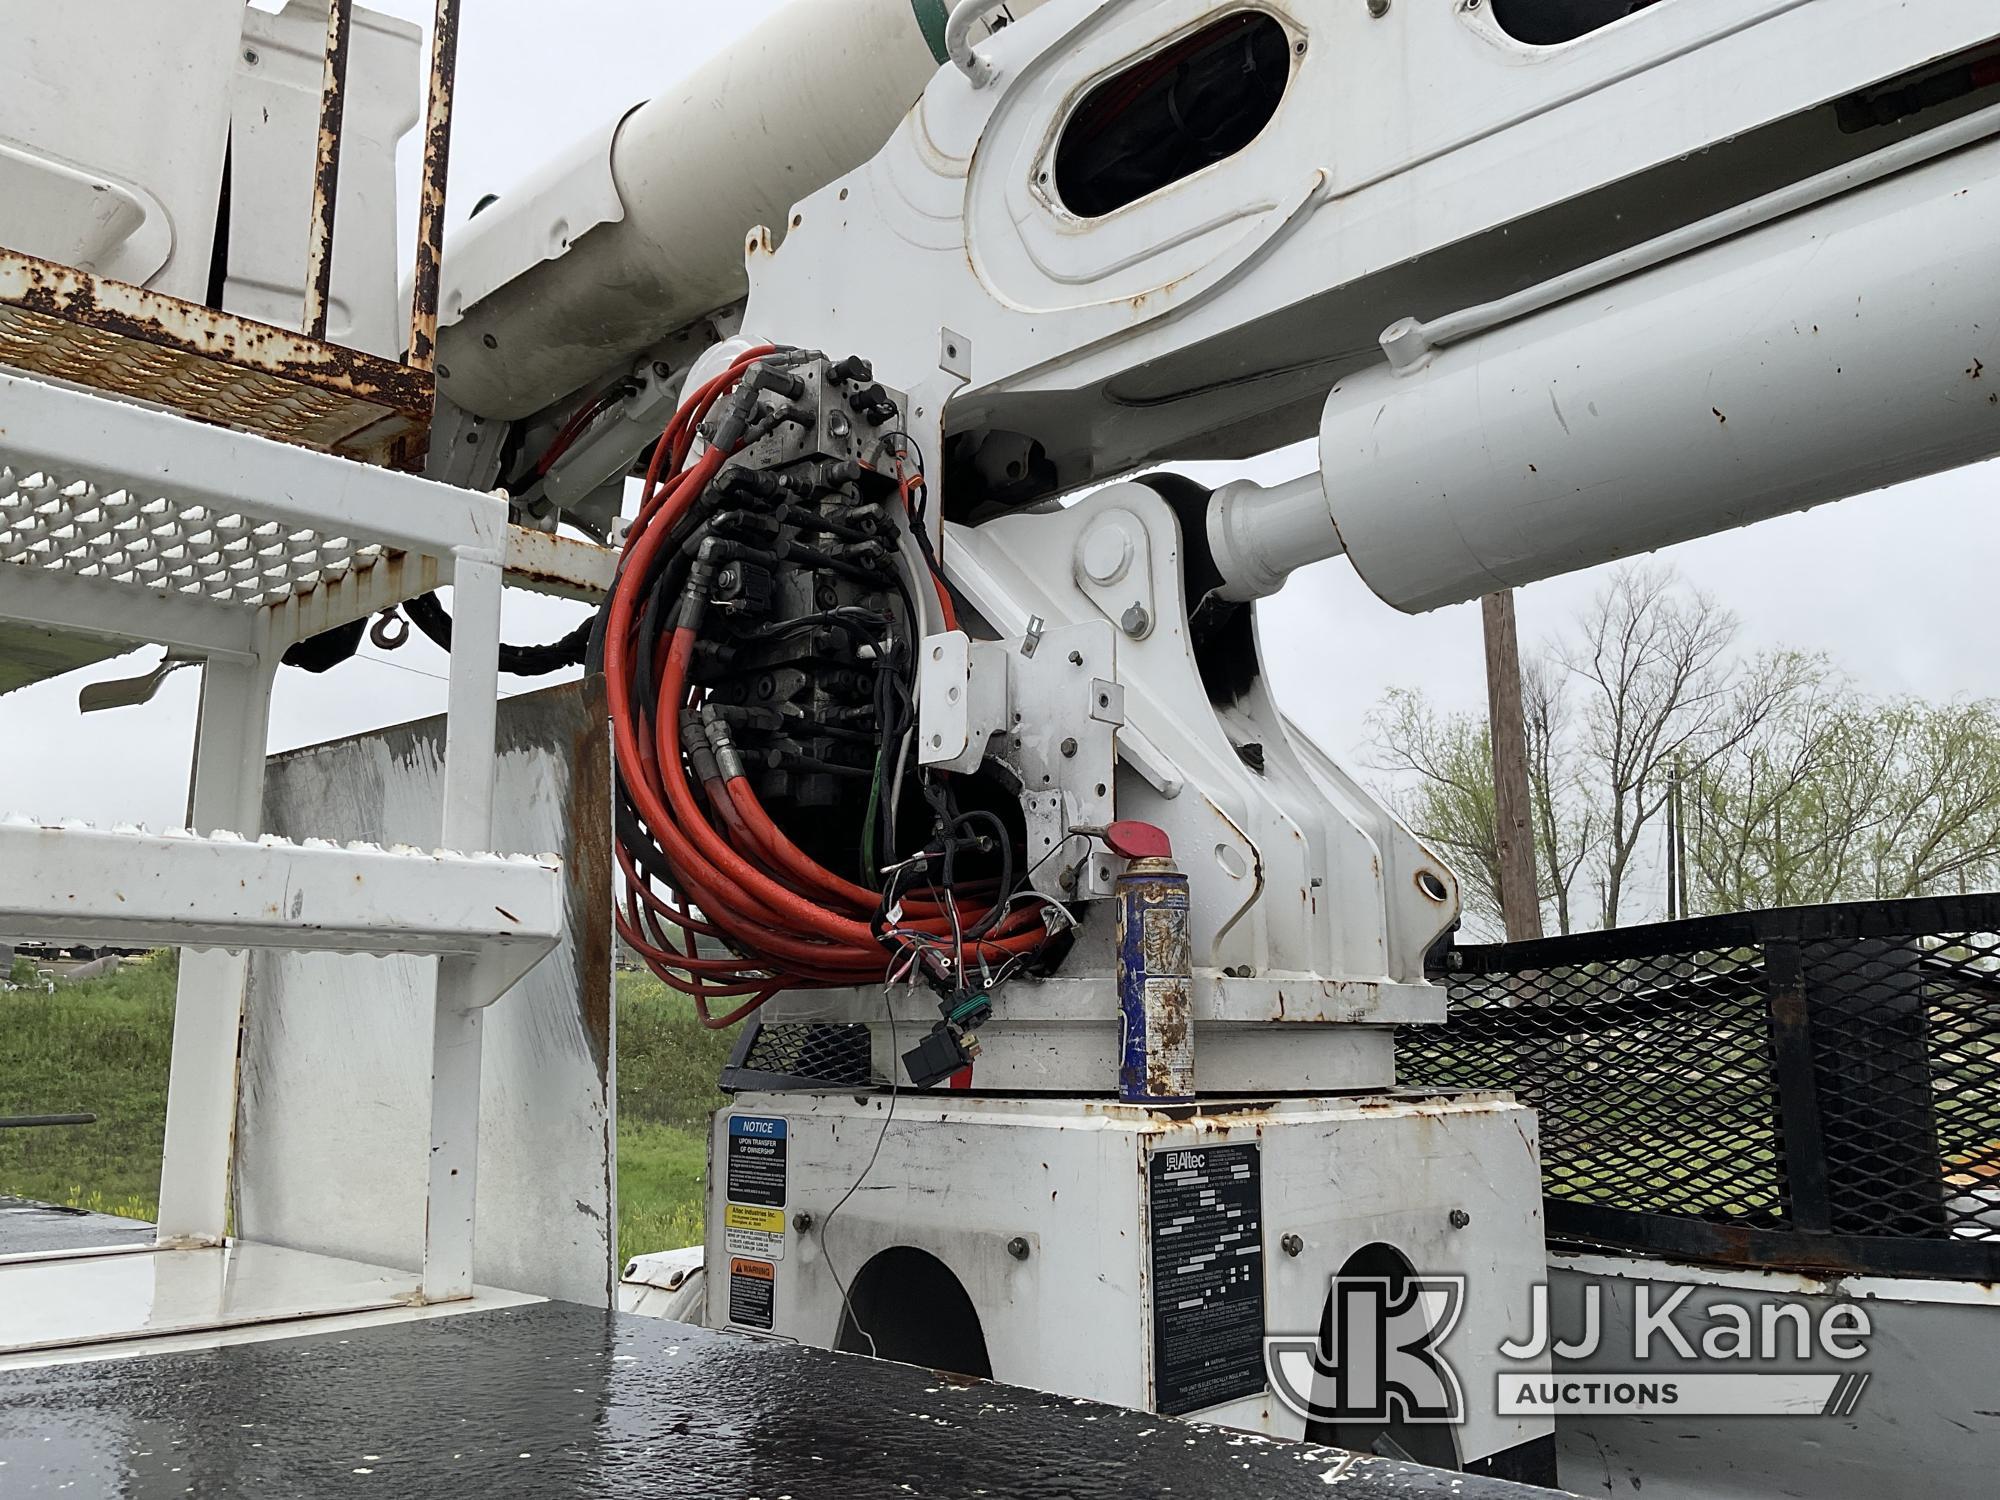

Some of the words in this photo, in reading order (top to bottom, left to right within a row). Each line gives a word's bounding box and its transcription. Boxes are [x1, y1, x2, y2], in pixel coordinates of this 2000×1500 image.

[743, 1121, 774, 1133] NOTICE
[752, 1139, 777, 1147] TRANSFER
[747, 1147, 775, 1155] OWNERSHIP
[1177, 1152, 1206, 1170] Altec
[744, 1209, 767, 1217] Industries
[743, 1265, 770, 1276] WARNING
